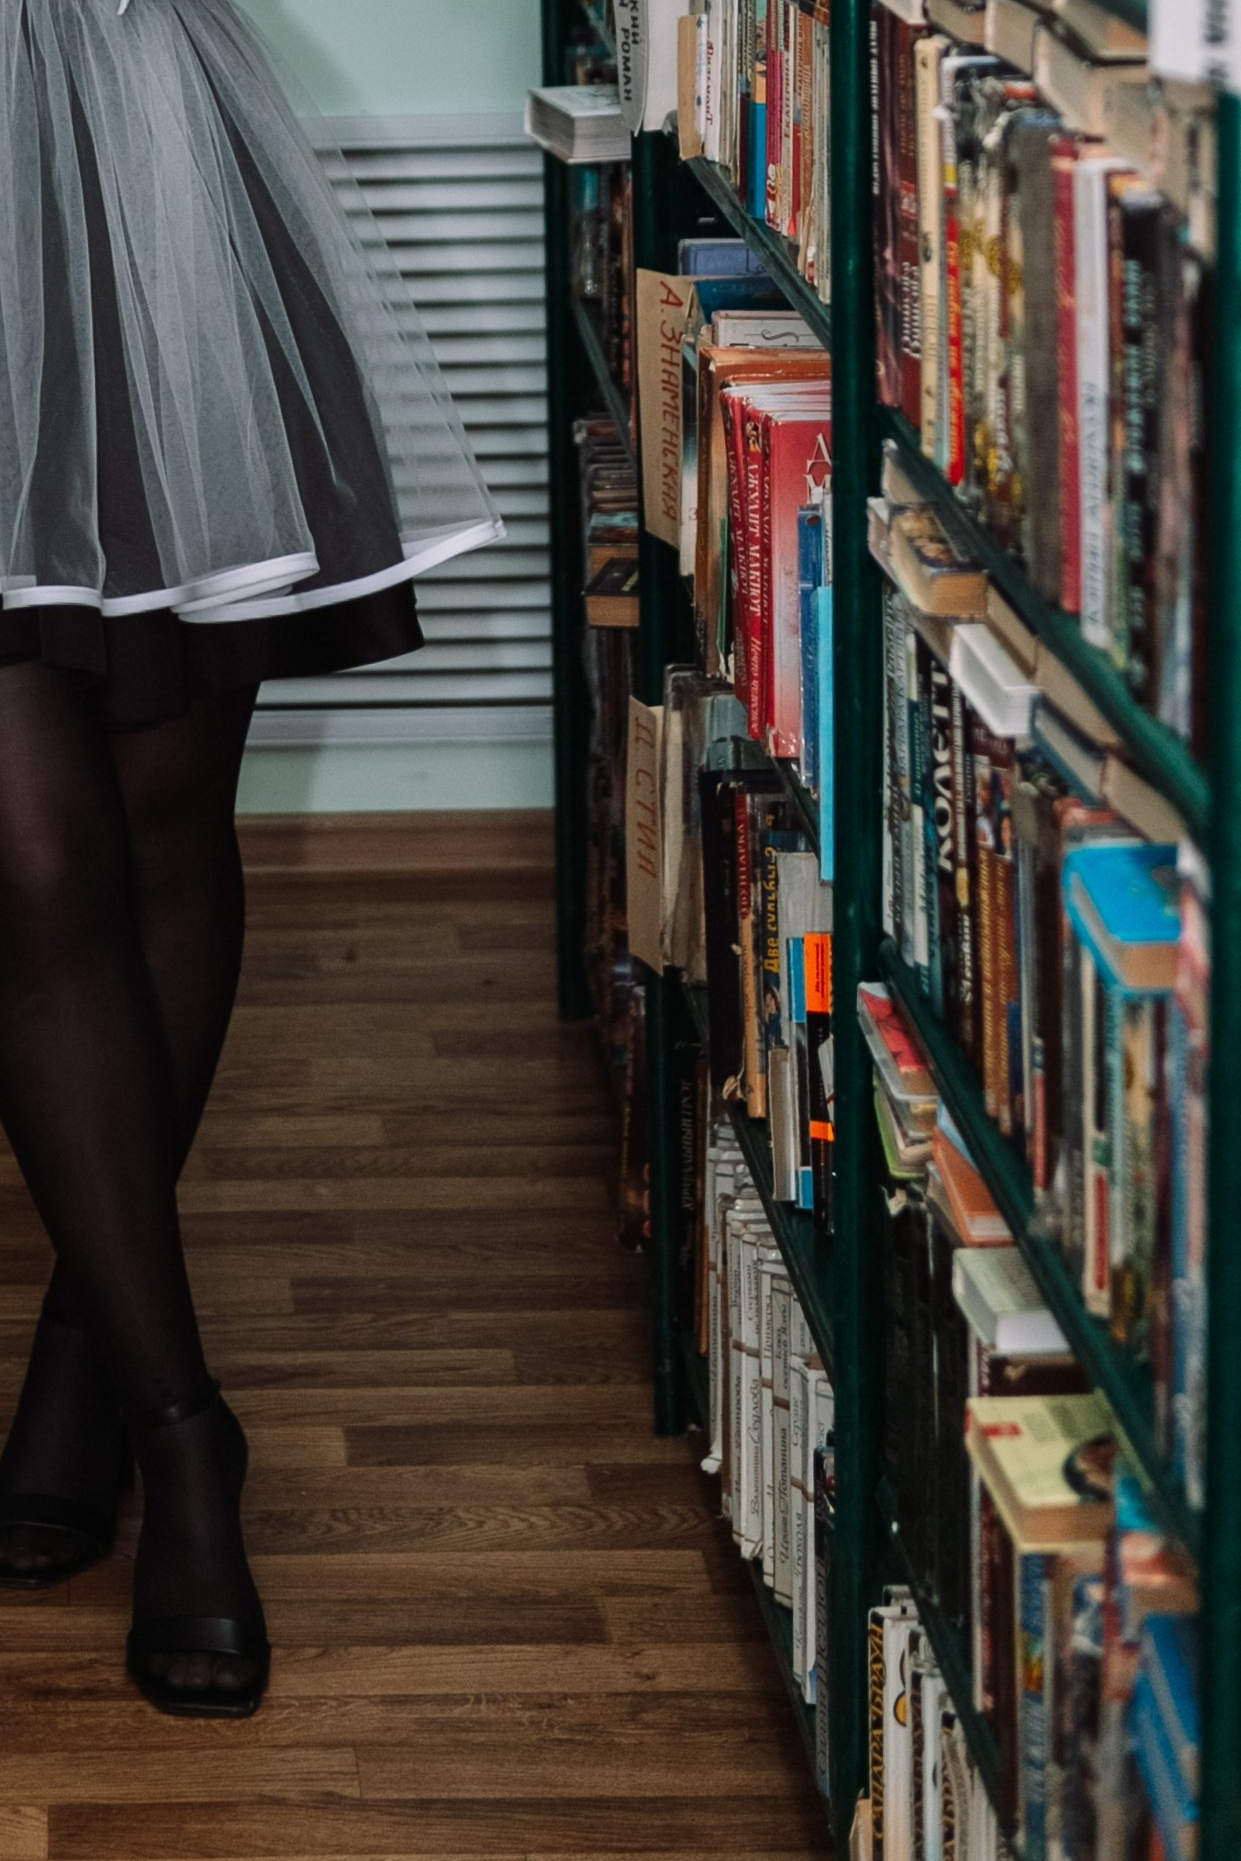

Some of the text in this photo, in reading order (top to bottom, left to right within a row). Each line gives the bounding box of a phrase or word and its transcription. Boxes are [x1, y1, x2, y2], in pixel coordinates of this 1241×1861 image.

[621, 27, 632, 102] РОМАН
[660, 320, 683, 520] ЗНАМЕНСКАЯ
[749, 543, 760, 617] МАКНОТ
[750, 636, 762, 677] Нечто
[750, 679, 761, 733] чудесное
[636, 767, 658, 879] СТИЛ
[764, 937, 779, 973] Две
